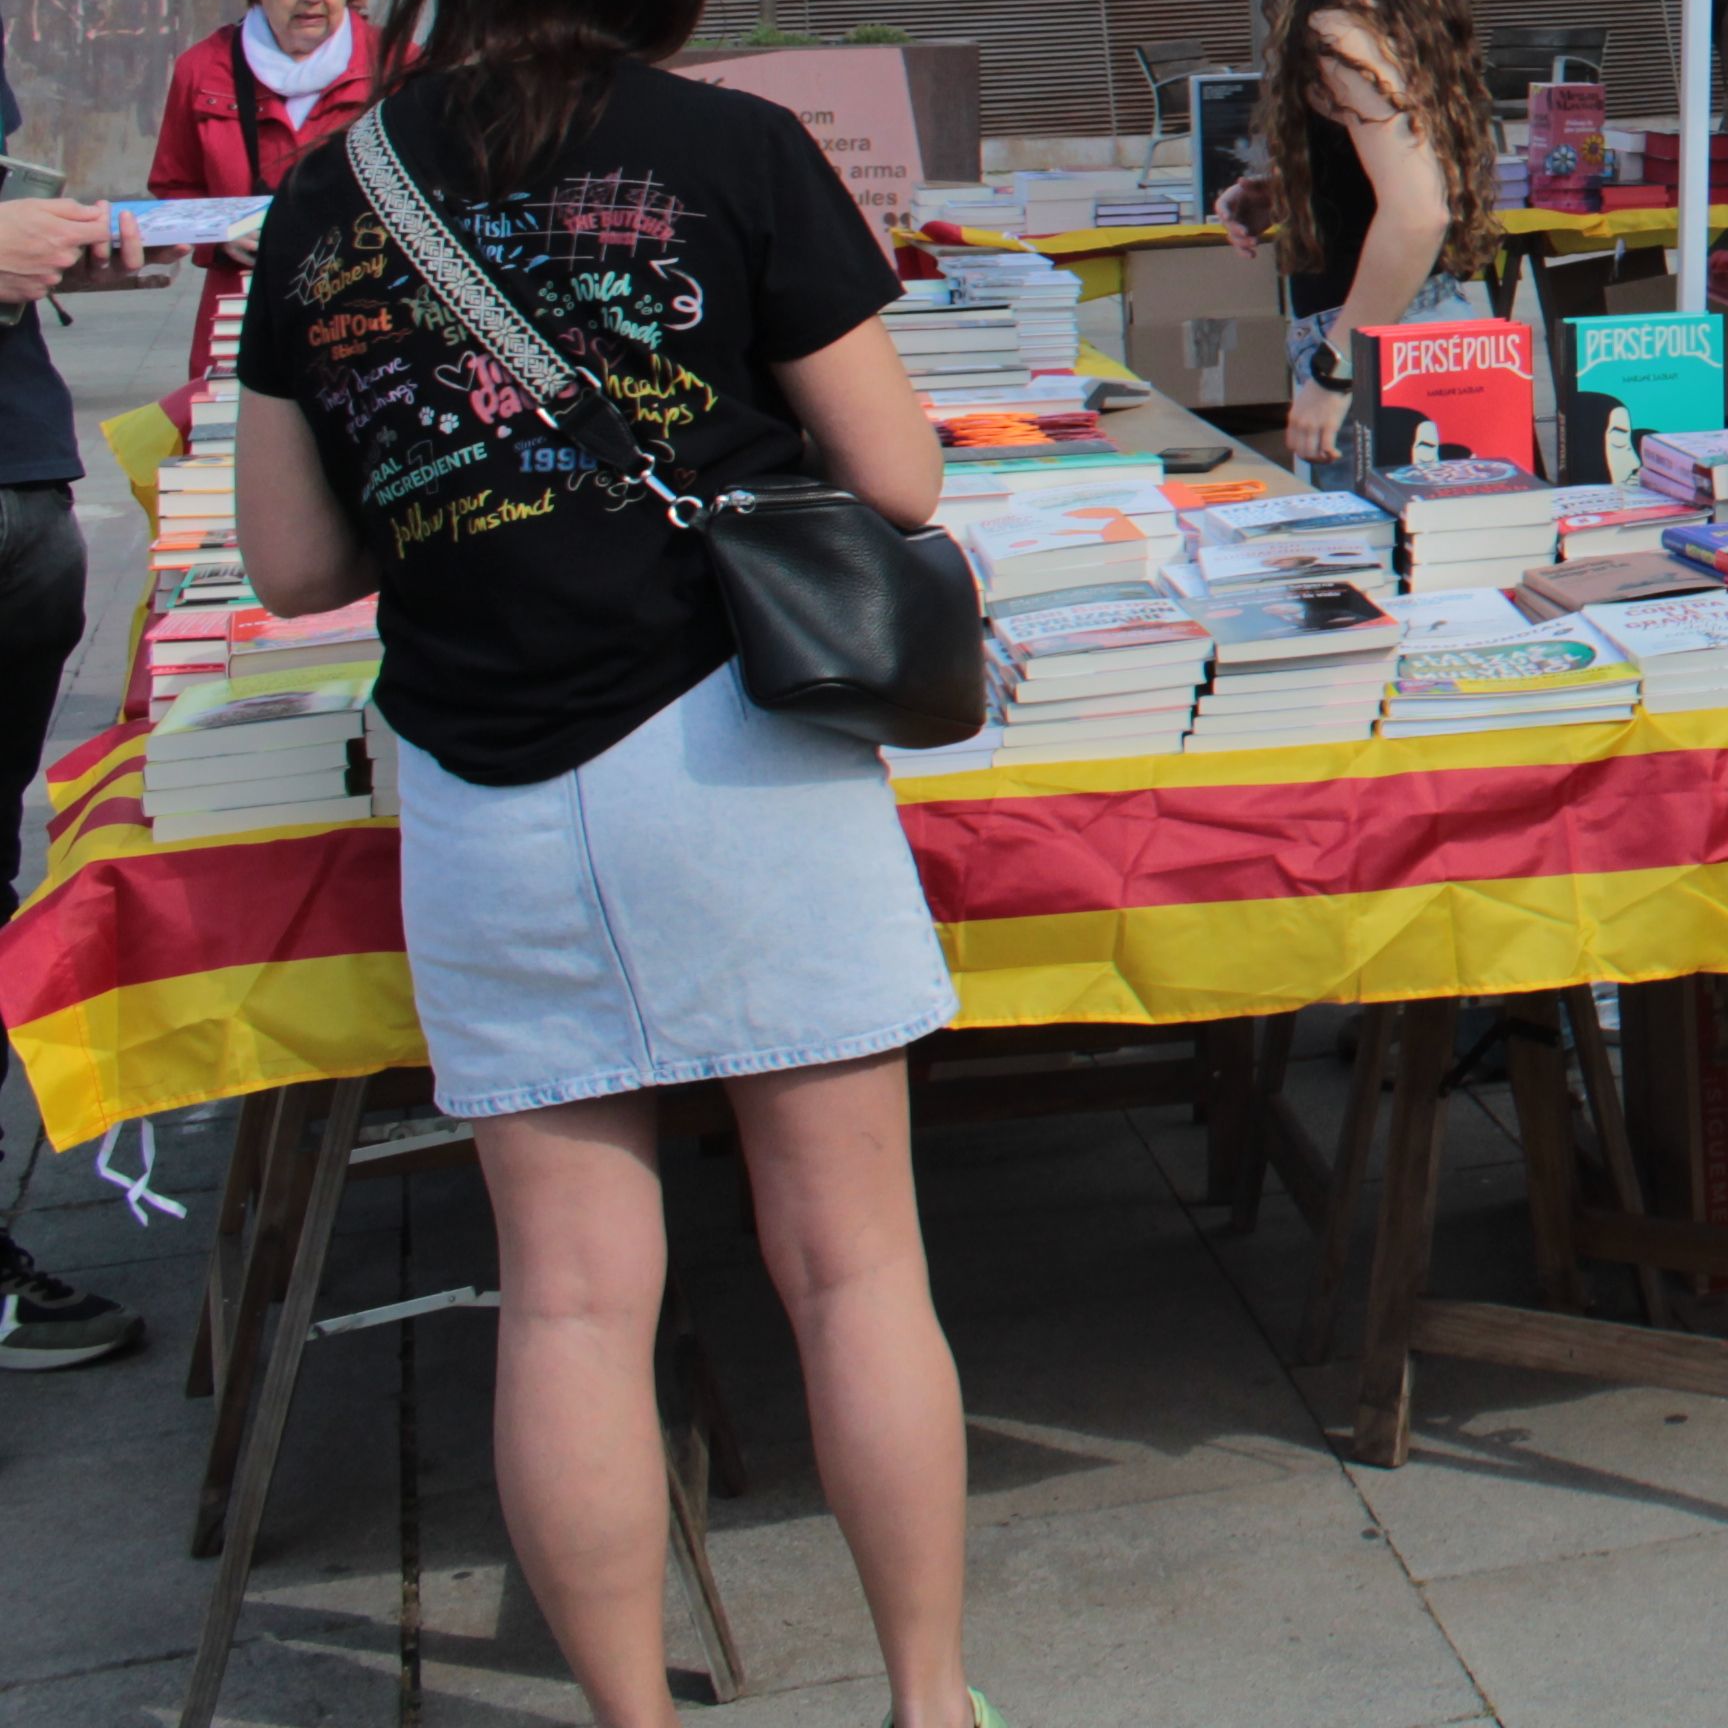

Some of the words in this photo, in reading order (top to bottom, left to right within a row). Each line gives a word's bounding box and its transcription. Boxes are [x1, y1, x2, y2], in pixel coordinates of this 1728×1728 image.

[850, 166, 908, 179] arma
[473, 212, 512, 239] Fish
[313, 254, 388, 303] Bakery
[571, 271, 632, 302] Wild
[1386, 334, 1530, 386] PERSÉPOLIS
[1580, 323, 1720, 373] PERSÉPOLIS
[375, 441, 489, 507] INGREDIENTE
[390, 501, 445, 560] follow
[449, 488, 494, 543] your
[466, 486, 557, 536] instinct
